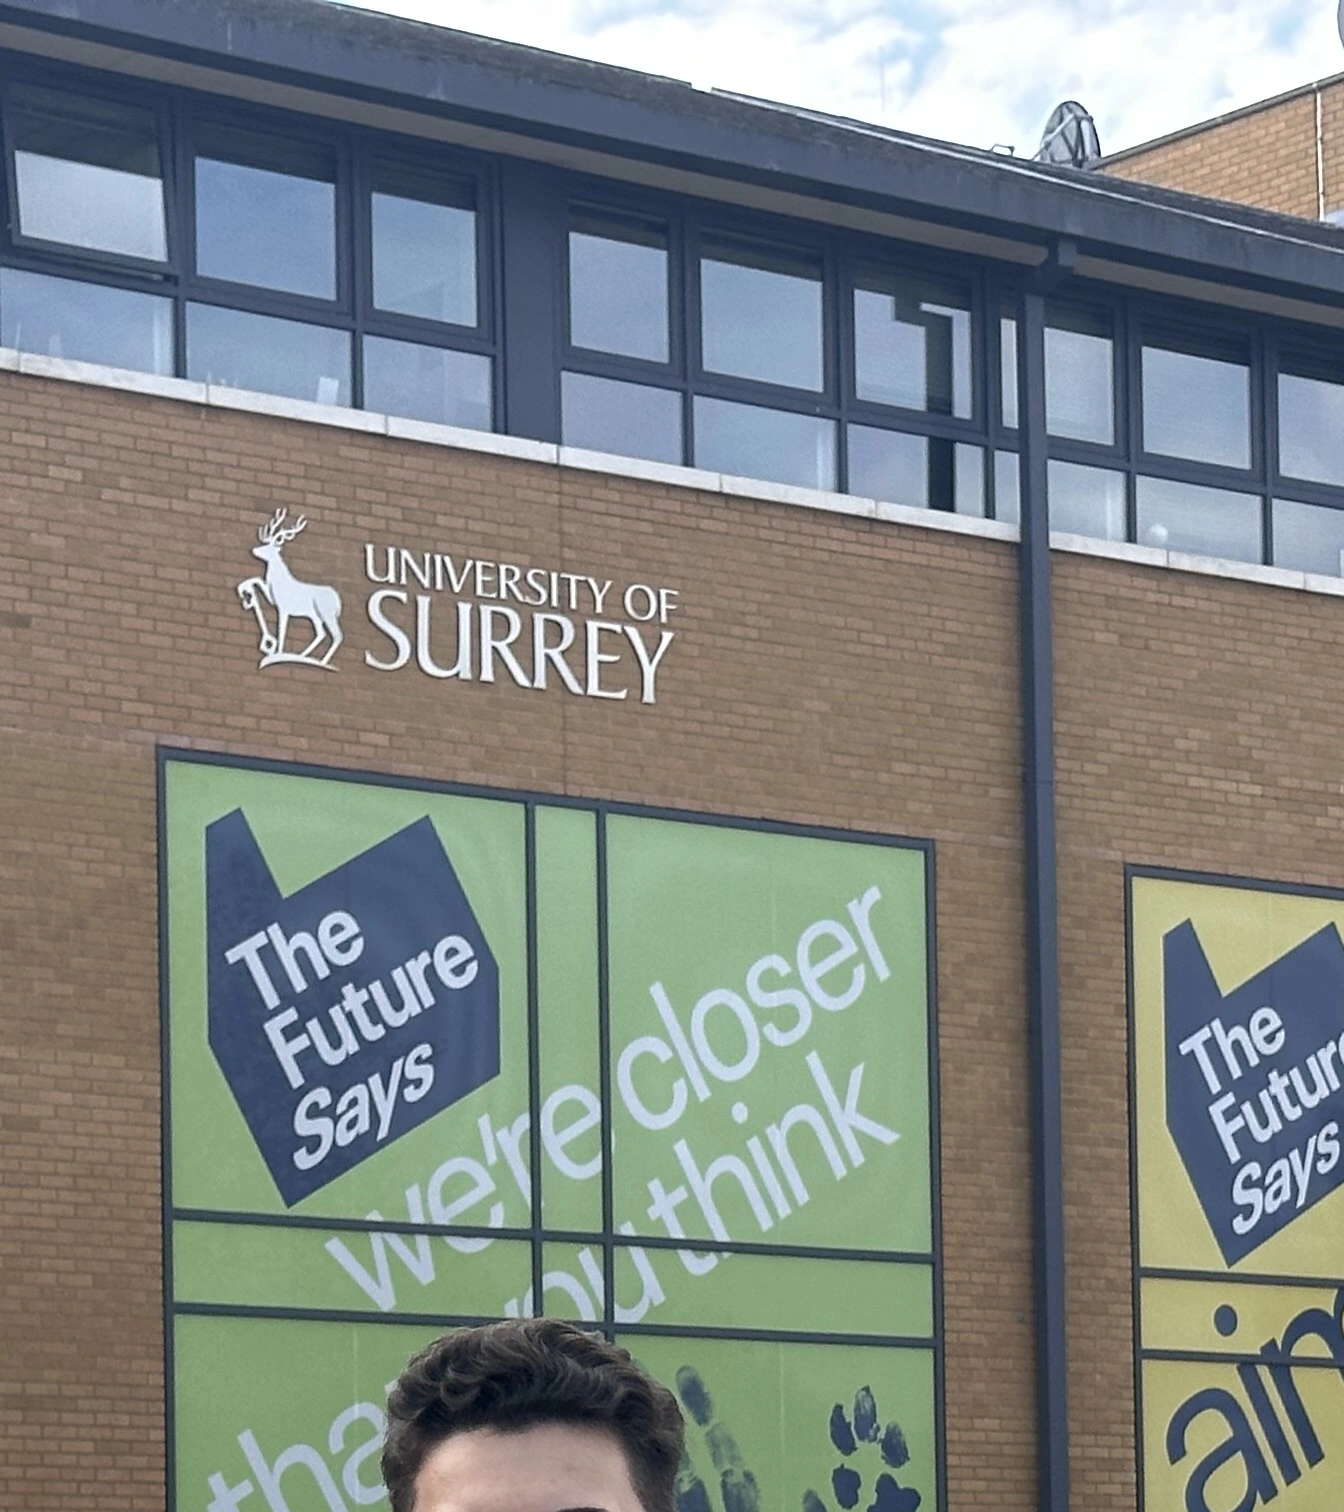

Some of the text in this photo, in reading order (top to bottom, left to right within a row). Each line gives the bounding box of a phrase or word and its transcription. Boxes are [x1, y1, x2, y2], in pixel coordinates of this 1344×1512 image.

[364, 543, 679, 624] UNIVERSITY OF
[364, 589, 675, 705] SURREY
[225, 909, 365, 1009] The
[263, 933, 479, 1090] Future
[291, 1043, 435, 1171] Says
[325, 885, 891, 1313] we're closer
[1179, 1006, 1286, 1095] The
[646, 1050, 902, 1277] think
[1231, 1120, 1341, 1235] Says
